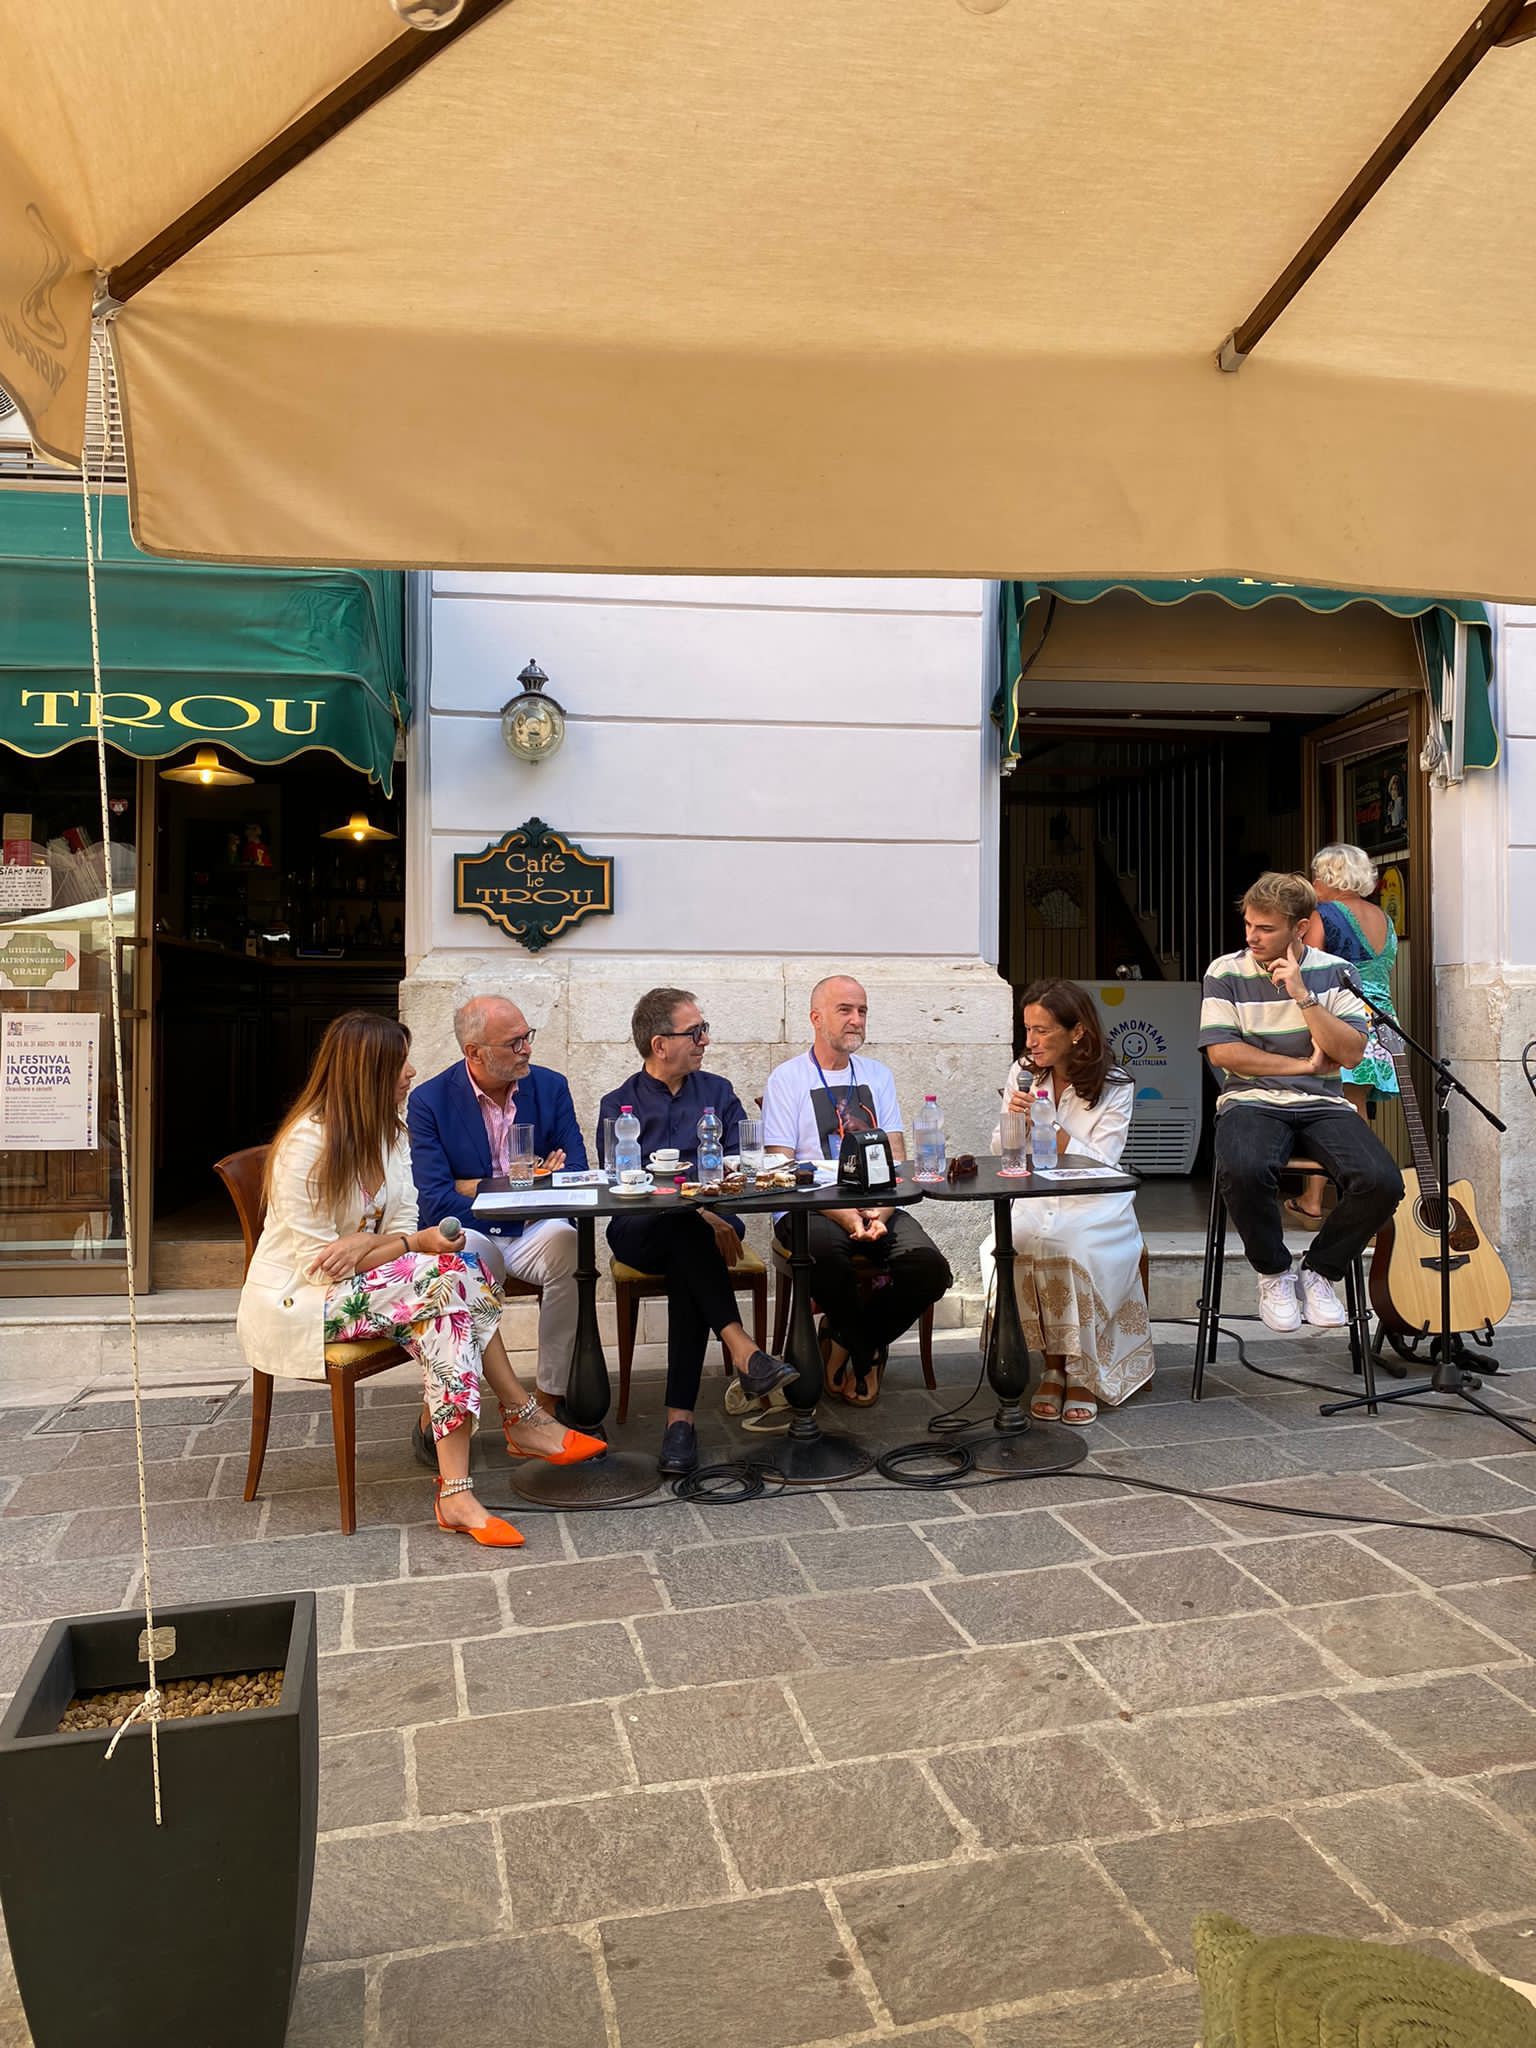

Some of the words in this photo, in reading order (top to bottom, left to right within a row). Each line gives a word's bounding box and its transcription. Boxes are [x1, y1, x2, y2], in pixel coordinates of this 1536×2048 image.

[21, 689, 327, 735] TROU
[505, 852, 566, 873] Café
[526, 873, 544, 888] Le
[475, 888, 594, 905] TROU
[12, 967, 47, 976] GRAZIE
[1106, 1019, 1167, 1053] AMMONTANA
[7, 1055, 16, 1064] IL
[19, 1055, 71, 1064] FESTIVAL
[6, 1065, 71, 1075] INCONTRA
[6, 1076, 21, 1085] LA
[24, 1076, 71, 1085] STAMPA
